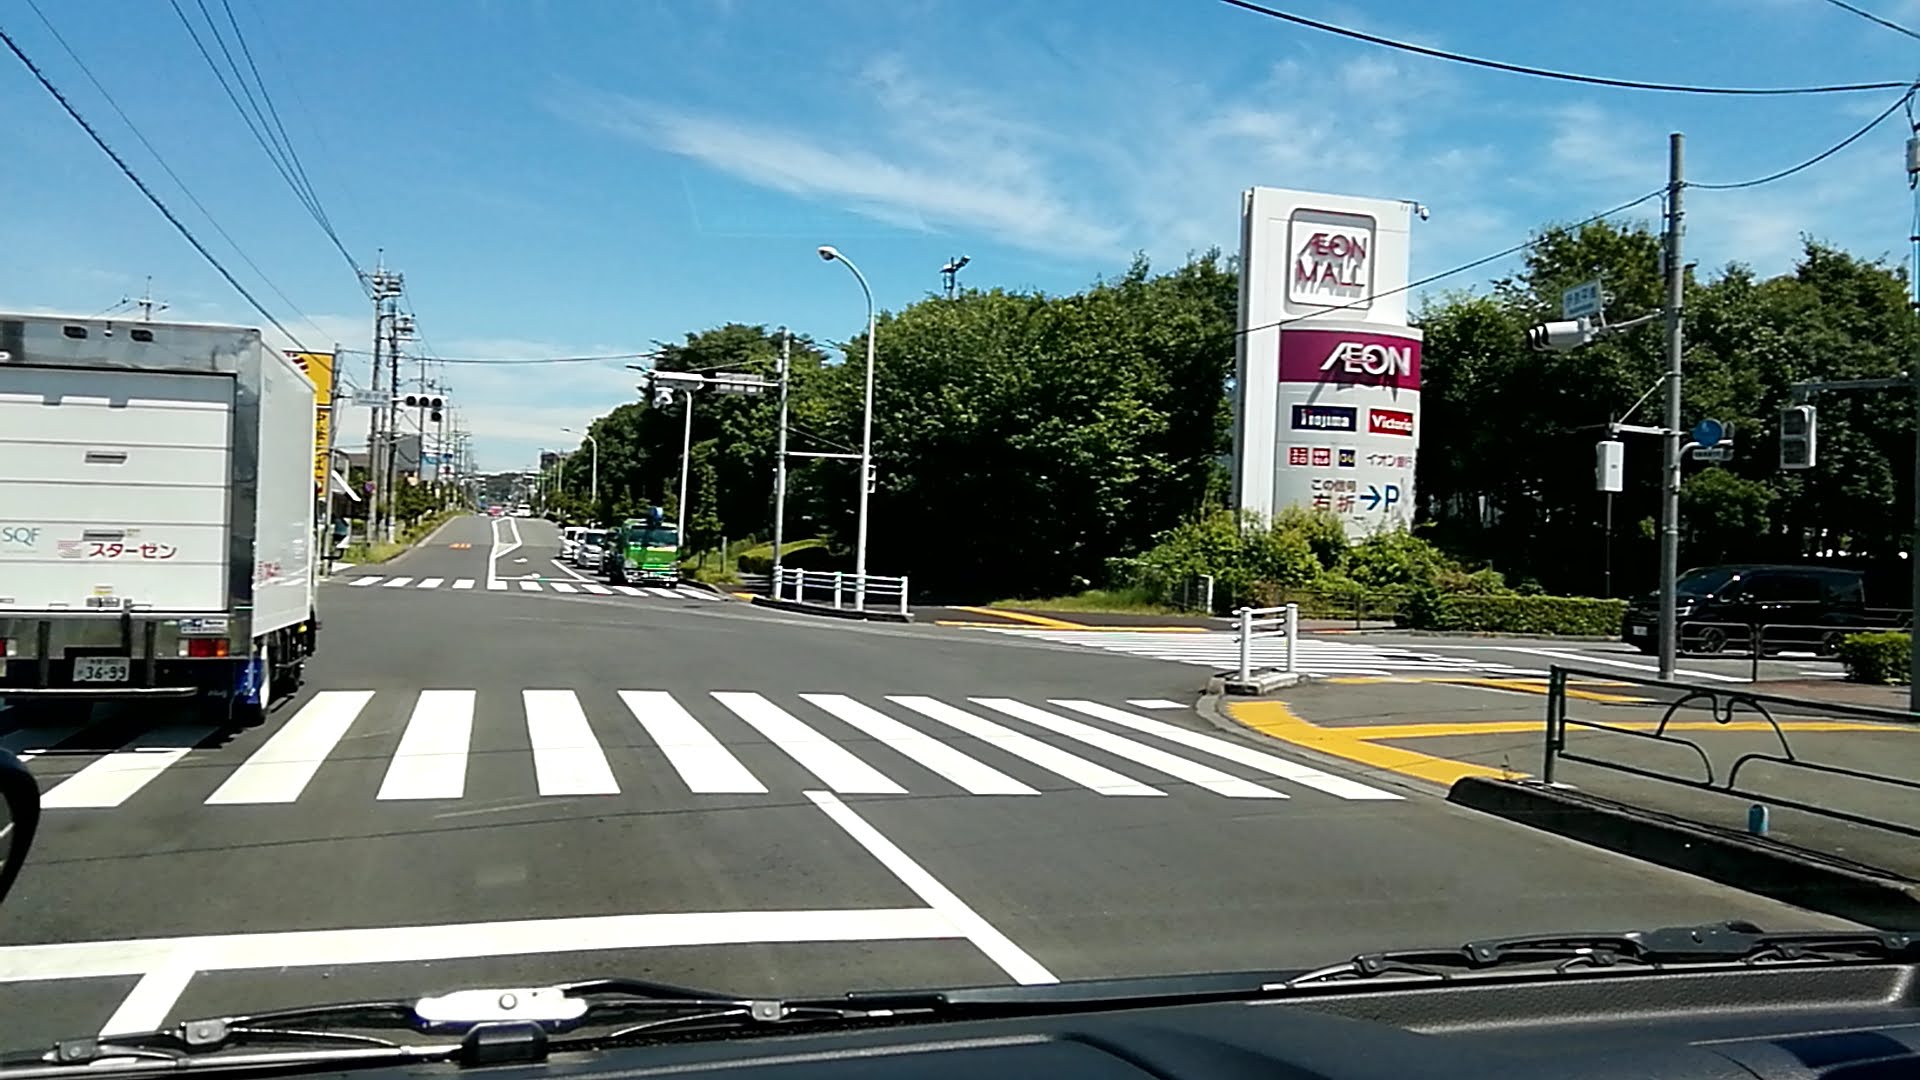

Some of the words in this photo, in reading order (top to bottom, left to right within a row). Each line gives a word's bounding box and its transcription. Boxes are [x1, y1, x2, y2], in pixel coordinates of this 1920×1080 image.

[1297, 259, 1366, 288] MALL
[1384, 484, 1401, 513] P
[2, 527, 41, 547] SQF
[88, 542, 178, 560] スターゼン
[85, 665, 127, 680] 36-99
